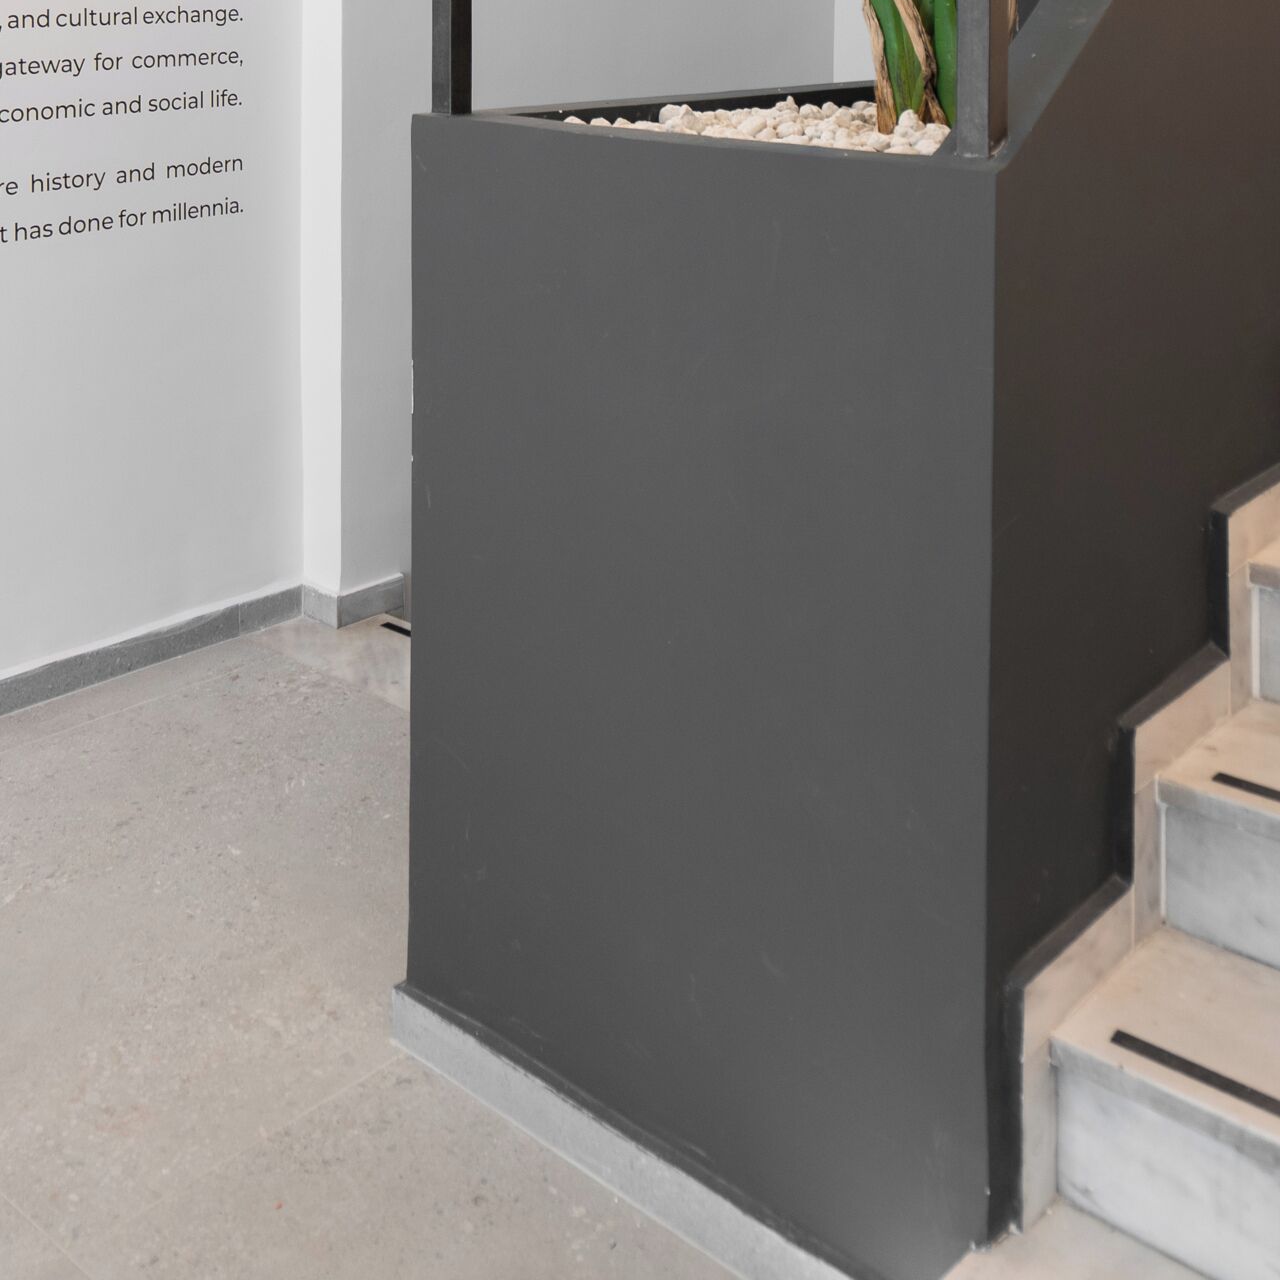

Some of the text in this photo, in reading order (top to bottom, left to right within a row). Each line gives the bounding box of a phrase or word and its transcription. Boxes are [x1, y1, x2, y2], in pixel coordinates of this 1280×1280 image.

[7, 8, 50, 30] and
[55, 5, 138, 28] cultural
[142, 4, 244, 27] exchange.
[93, 51, 124, 72] for
[131, 50, 244, 70] commerce,
[101, 94, 142, 116] and
[148, 90, 204, 113] social
[210, 88, 243, 109] life.
[31, 171, 107, 194] history
[116, 161, 156, 185] and
[166, 156, 243, 180] modern
[14, 221, 54, 242] has
[58, 215, 115, 236] done
[117, 208, 148, 229] for
[152, 196, 244, 225] millennia.
